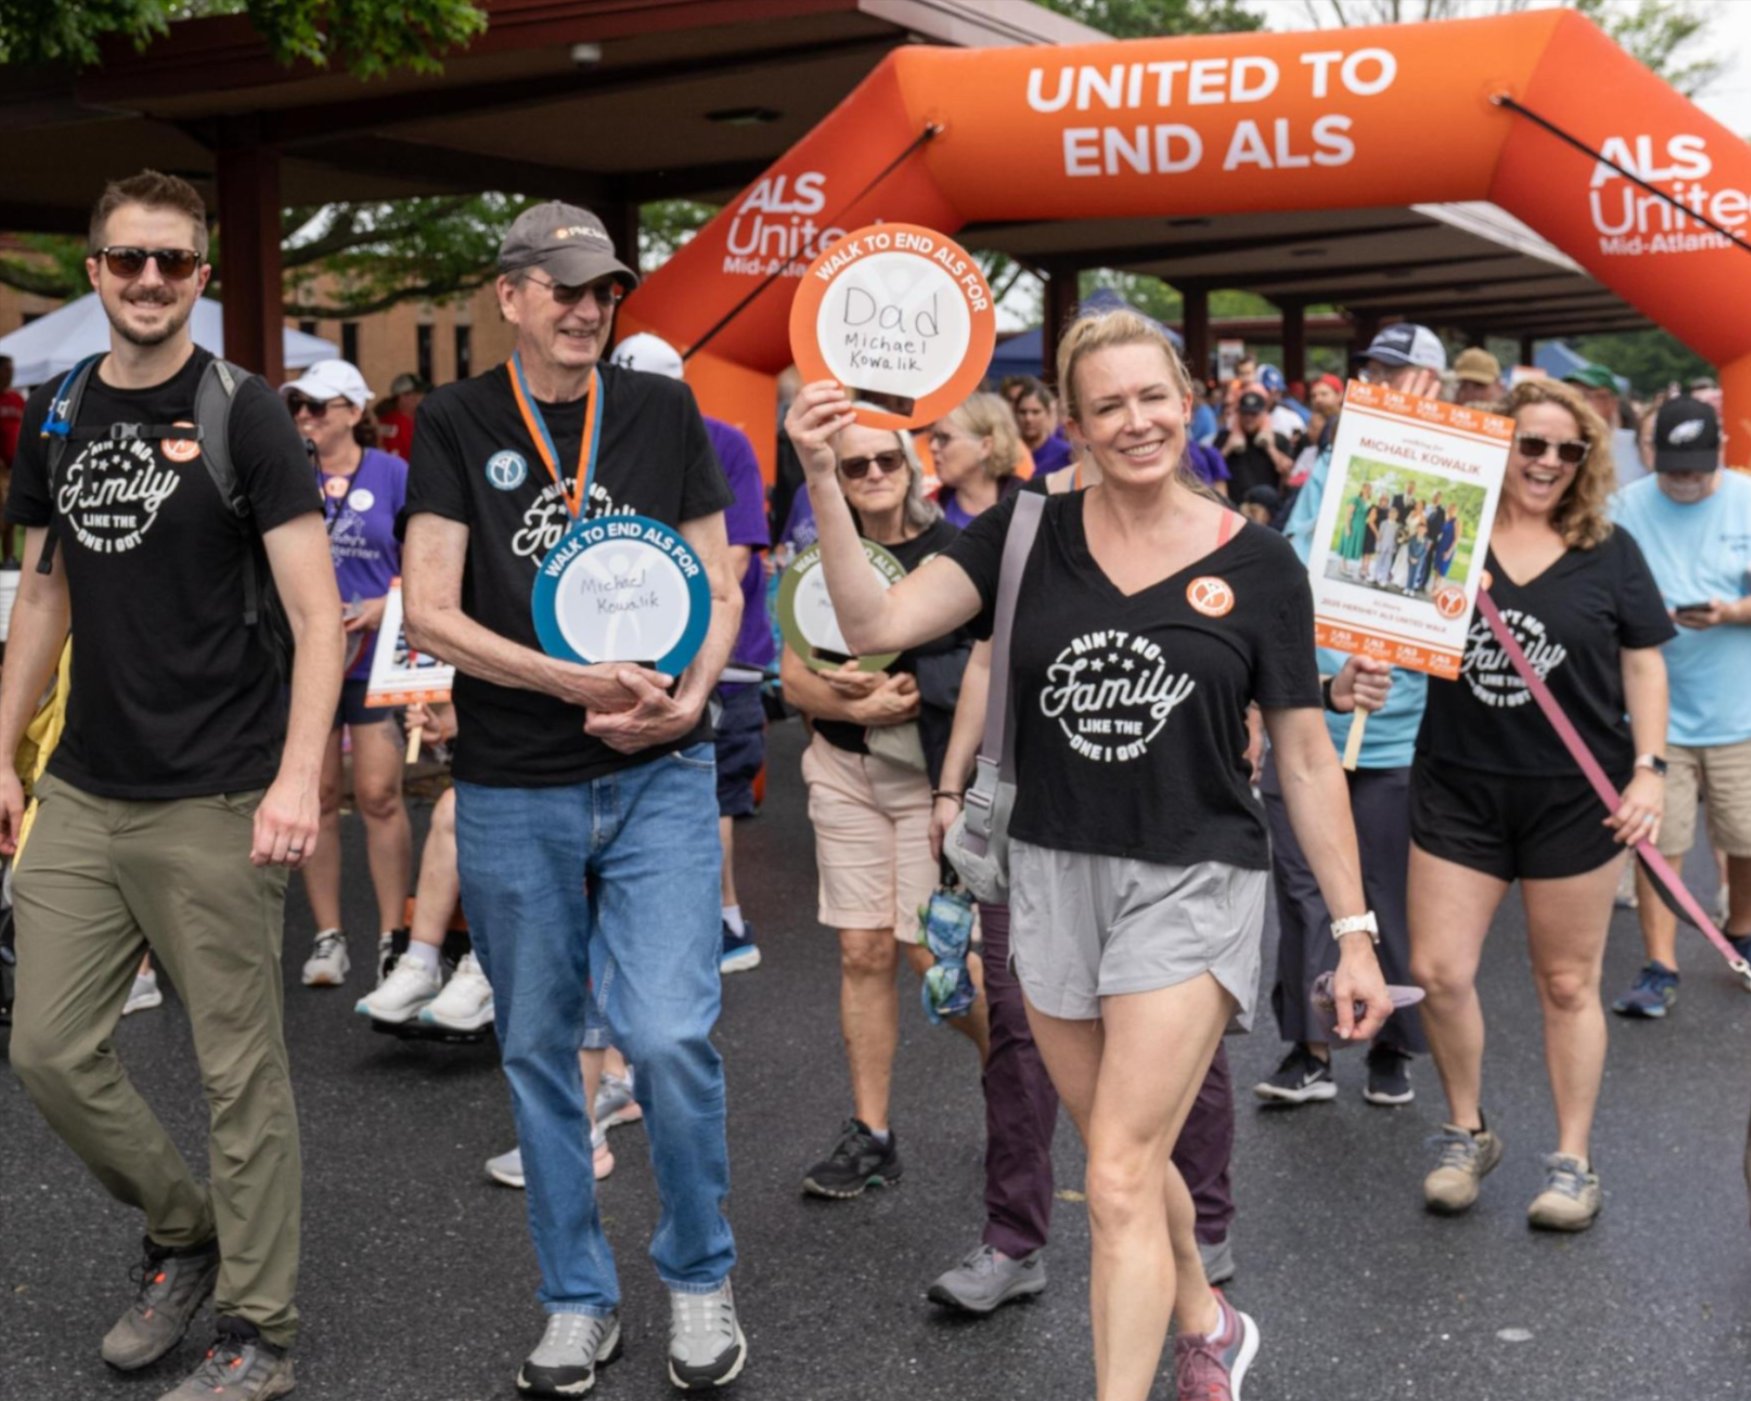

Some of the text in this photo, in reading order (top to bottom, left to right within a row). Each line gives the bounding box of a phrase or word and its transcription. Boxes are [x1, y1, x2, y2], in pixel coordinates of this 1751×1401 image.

[1026, 47, 1398, 113] UNITED TO
[1062, 114, 1356, 177] END ALS
[1590, 133, 1713, 188] ALS
[737, 171, 827, 216] ALS
[1589, 181, 1751, 237] Unite
[726, 215, 872, 260] Unite
[816, 232, 988, 313] WALK TO END ALS FOR
[843, 286, 939, 338] Dad
[844, 332, 927, 354] Michael
[850, 350, 923, 372] Kowalik
[1359, 436, 1482, 475] MICHAEL KOWALIK
[58, 457, 180, 514] Fmily
[82, 513, 137, 529] LIKE THE
[77, 528, 142, 553] ONE I GOT
[545, 538, 584, 578] WALK
[580, 527, 605, 545] TO
[607, 522, 642, 538] END
[643, 527, 675, 551] ALS
[670, 546, 700, 578] FOR
[580, 569, 647, 594] Michael
[873, 555, 897, 576] ALS
[595, 591, 660, 615] Kowalik
[1521, 615, 1545, 636] NO
[1071, 629, 1161, 661] AIN'T NO
[1040, 657, 1195, 720] Family
[1472, 684, 1531, 707] ONE I GOT
[1478, 673, 1505, 687] LIKE
[1078, 718, 1143, 735] LIKE THE
[1069, 734, 1147, 762] ONE I GOT
